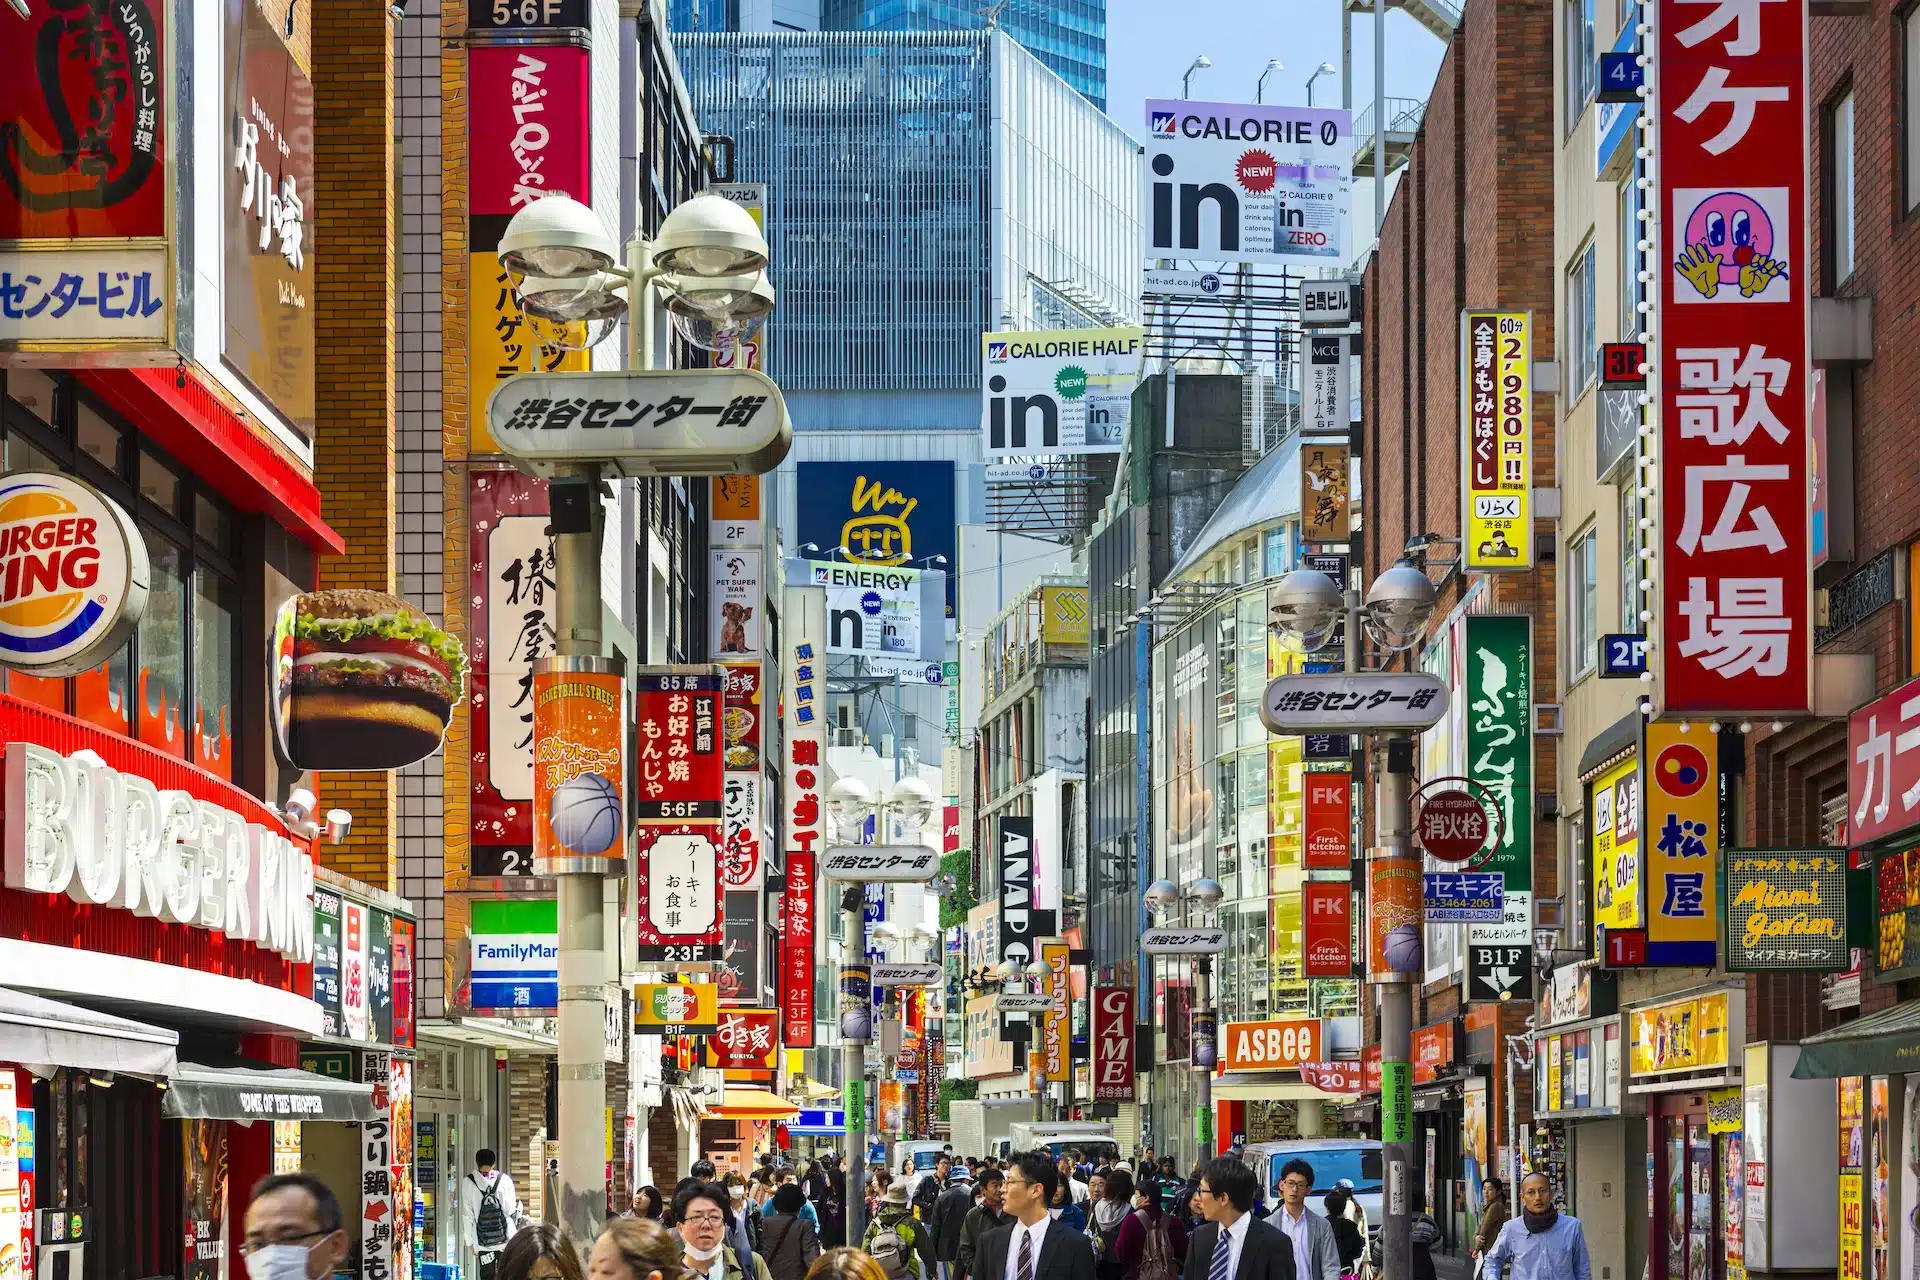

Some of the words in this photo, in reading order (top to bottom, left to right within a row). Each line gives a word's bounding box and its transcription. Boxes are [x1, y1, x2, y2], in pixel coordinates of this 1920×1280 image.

[120, 4, 155, 152] とうがらし料理
[1611, 62, 1639, 82] 4F
[1181, 115, 1312, 144] CALORIE
[1242, 167, 1273, 177] NEW!
[1152, 153, 1239, 252] in
[1288, 192, 1326, 200] CALORIE
[1279, 202, 1304, 227] in
[1287, 231, 1326, 246] ZERO
[1147, 278, 1200, 287] hit-ad.co.jp
[1305, 291, 1347, 311] 白馬ビル
[1500, 318, 1523, 334] 60分
[1011, 342, 1089, 358] CALORIE
[1093, 339, 1139, 356] HALF
[1312, 346, 1339, 357] MCC
[1060, 378, 1085, 388] NEW!
[989, 375, 1058, 448] in
[1474, 322, 1494, 485] 全身もみほぐし
[504, 396, 768, 431] 渋谷センター街
[1090, 404, 1109, 424] in
[1102, 426, 1121, 438] 1/2
[987, 469, 1029, 477] hit-ad.co.jp
[1481, 500, 1515, 516] りらく
[1675, 344, 1792, 679] 歌広場
[727, 526, 745, 538] 2F
[1484, 520, 1512, 529] 渋谷店
[832, 569, 913, 591] ENERGY
[884, 622, 896, 636] in
[892, 638, 905, 647] 180
[871, 665, 924, 678] hit-ad.co.jp
[660, 676, 698, 691] 85席
[1274, 688, 1439, 712] 渋谷センター街
[695, 699, 712, 751] 江戸前
[668, 695, 689, 782] お好み焼
[642, 719, 663, 797] もんじゃ
[546, 762, 606, 790] ストリート
[1313, 787, 1343, 804] FK
[1429, 800, 1444, 808] FIRE
[1445, 800, 1476, 808] HYDRANT
[1424, 812, 1483, 839] 消火栓
[5, 742, 250, 940] BURGER
[1309, 843, 1346, 851] Kitchen
[826, 855, 932, 869] 渋谷センター街
[1656, 811, 1708, 918] 松屋
[686, 842, 700, 907] ケーキと
[1004, 831, 1029, 933] ANAP
[1424, 876, 1502, 898] セキネ
[1732, 881, 1822, 909] Miami
[665, 875, 682, 927] お食事
[1313, 898, 1343, 915] FK
[1147, 934, 1225, 945] 渋谷センター街
[1472, 930, 1527, 939] おろししそハンバーグ
[478, 944, 558, 961] FamilyMar
[1309, 953, 1346, 961] Kitchen
[1317, 946, 1339, 954] First
[1612, 936, 1636, 961] 1F
[1745, 950, 1832, 961] マイアミガーデン
[1478, 950, 1522, 965] B1F
[874, 968, 939, 978] 渋谷センター街
[514, 987, 530, 1005] 酒
[790, 989, 807, 1000] 2F
[790, 1008, 807, 1019] 3F
[665, 1025, 685, 1034] B1F
[717, 1014, 769, 1052] すき家
[790, 1026, 807, 1037] 4F
[1100, 991, 1129, 1083] GAME
[1096, 1087, 1132, 1097] 渋谷会館
[274, 1094, 290, 1112] THE
[290, 1094, 324, 1113] WHOPPER
[1233, 1135, 1246, 1144] 4F
[197, 1221, 210, 1239] BK
